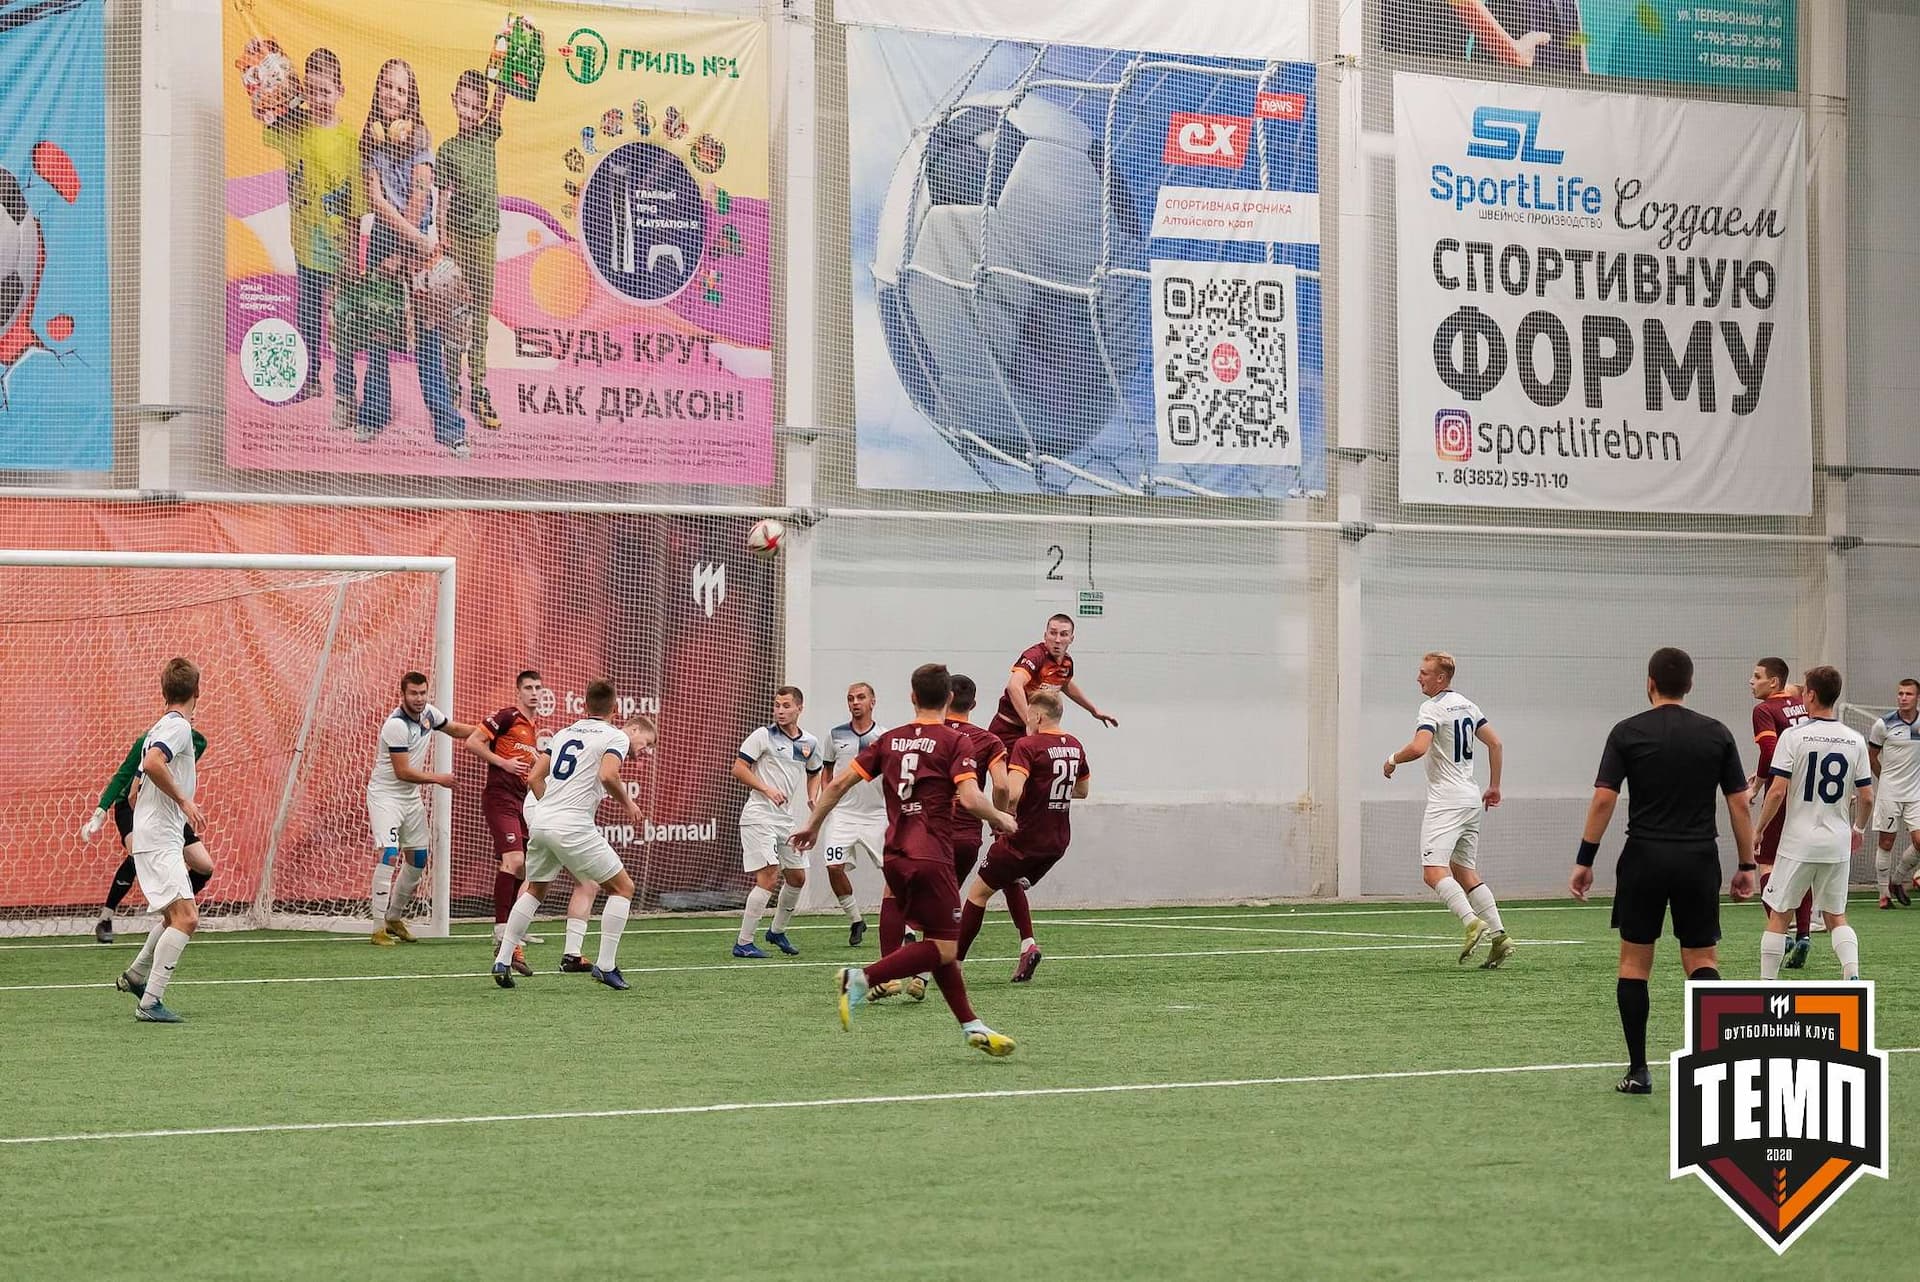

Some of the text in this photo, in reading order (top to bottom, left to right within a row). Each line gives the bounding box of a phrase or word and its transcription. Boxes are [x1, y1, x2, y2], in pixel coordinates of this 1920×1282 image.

[618, 48, 740, 79] ГРИЛЬ №1
[1261, 99, 1293, 113] news
[1467, 106, 1565, 165] SL
[1165, 199, 1293, 214] СПОРТИВНАЯ ХРОНИКА
[1430, 165, 1602, 215] SportLife
[636, 219, 689, 229] PLAYSTATION
[1478, 208, 1603, 229] ШВЕЙНОЕ ПРОИЗВОДСТВО
[1615, 177, 1786, 251] Создаем
[1432, 238, 1777, 310] СПОРТИВНУЮ
[514, 327, 723, 372] БУДЬ КРУТ,
[1433, 305, 1775, 416] ФОРМУ
[518, 383, 745, 424] КАК ДРАКОН!
[1477, 417, 1682, 464] sportlifebrn
[1453, 468, 1509, 488] 8(3852)
[1511, 471, 1569, 489] 59-11-10
[1046, 544, 1064, 581] 2
[552, 739, 584, 780] 6
[1454, 717, 1475, 763] 10
[897, 752, 920, 801] 5
[1049, 759, 1080, 801] 25
[1803, 751, 1848, 804] 18
[1887, 816, 1895, 830] 7
[826, 846, 843, 861] 96
